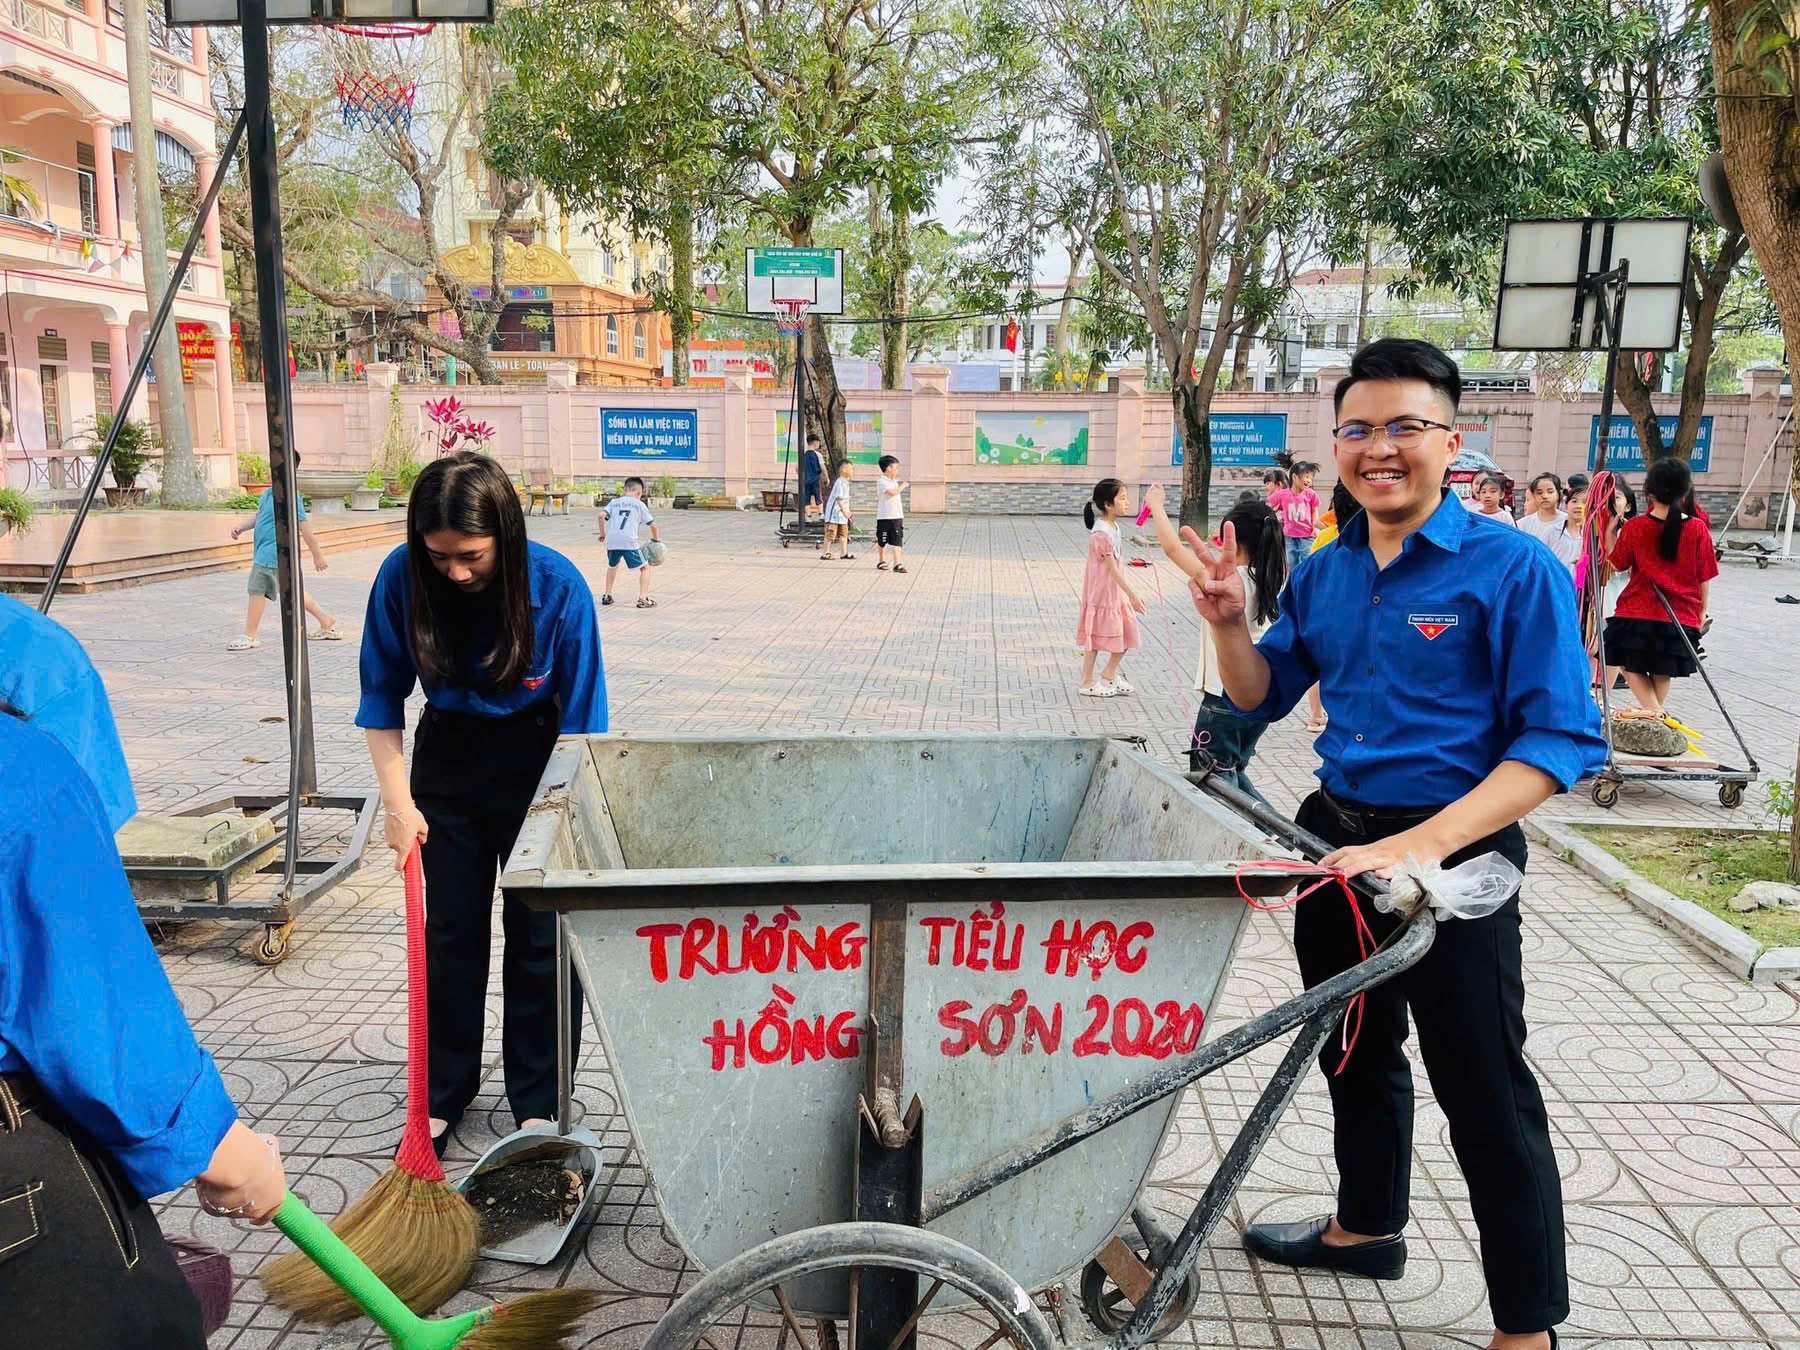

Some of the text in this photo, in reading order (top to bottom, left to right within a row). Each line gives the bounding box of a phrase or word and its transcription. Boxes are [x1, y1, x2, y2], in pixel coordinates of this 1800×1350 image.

[608, 415, 690, 431] SỐNG VÀ LÀM VIỆC THEO
[1209, 420, 1218, 430] ÊU
[607, 432, 692, 448] HIẾN PHÁP VÀ PHÁP LUẬT
[1231, 433, 1245, 443] DUY
[1245, 431, 1264, 443] NHẤT
[1617, 446, 1630, 459] AN
[618, 509, 631, 530] 7
[636, 901, 1155, 983] TRƯỜNG TIỂU HỌC
[702, 983, 1205, 1071] HỒNG SƠN 2020
